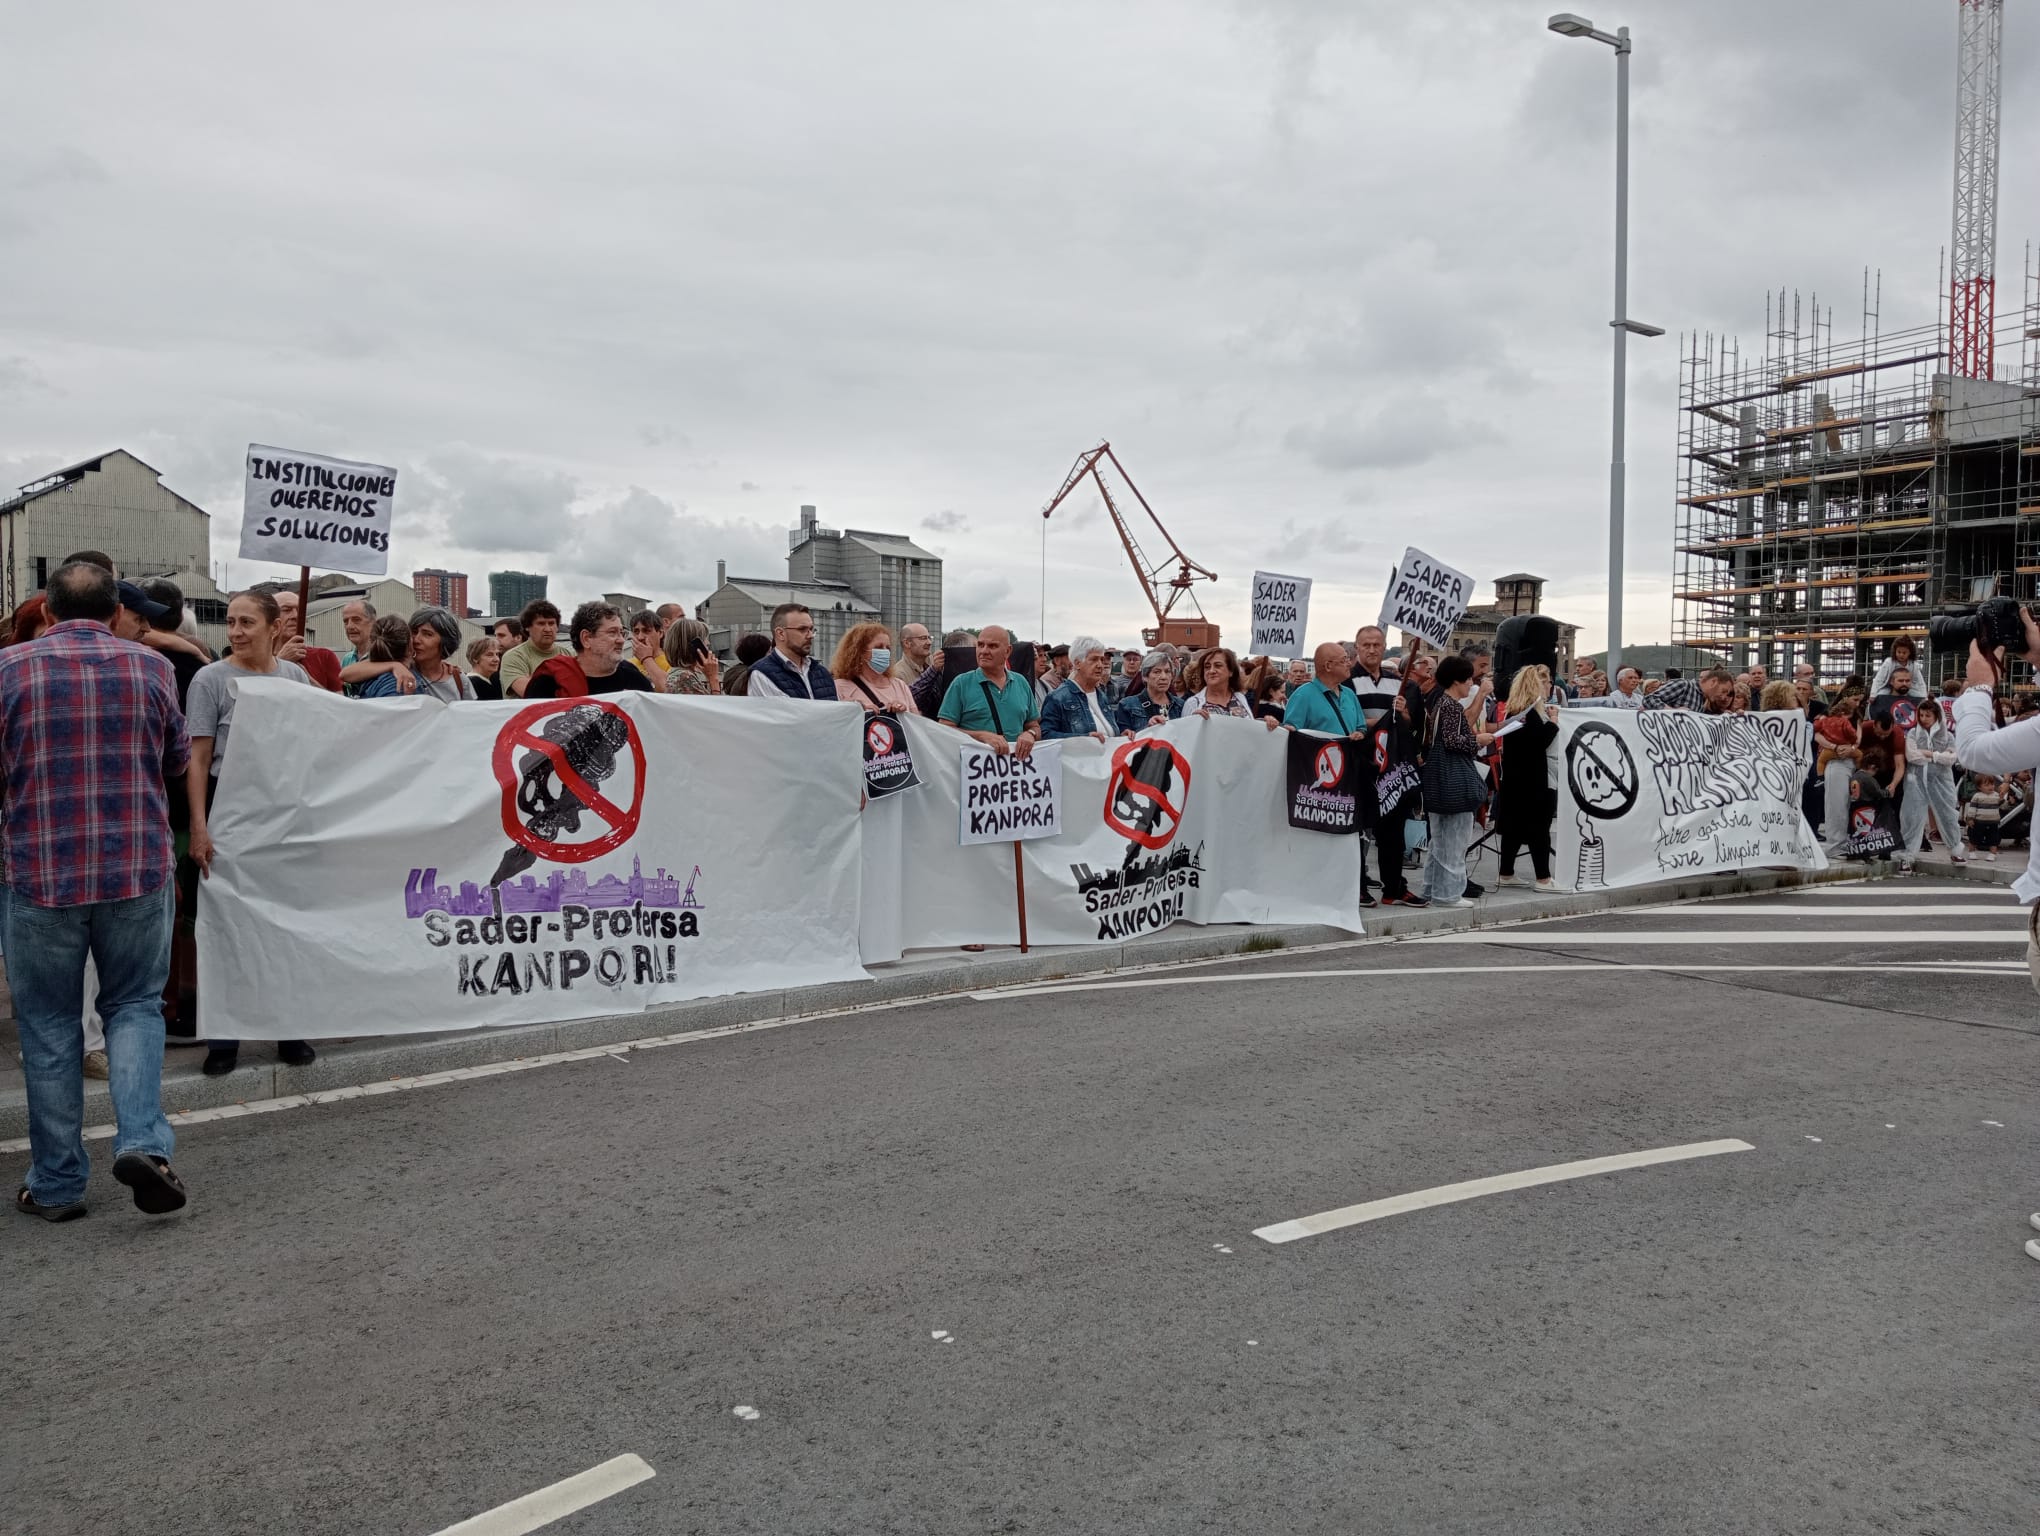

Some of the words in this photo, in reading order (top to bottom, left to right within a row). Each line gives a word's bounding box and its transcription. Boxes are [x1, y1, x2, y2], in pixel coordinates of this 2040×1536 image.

[252, 458, 395, 497] INSTITUCIONES
[256, 517, 389, 552] SOLUCIONES
[1254, 581, 1296, 602] SADER
[1405, 560, 1462, 602] SADER
[1394, 581, 1461, 626] PROFERSA
[1393, 605, 1451, 647] KANPORA
[869, 765, 909, 780] KANPORA!
[968, 752, 1036, 780] SADER
[968, 776, 1052, 808] PROFERSA
[970, 802, 1054, 834] KANPORA
[424, 900, 700, 946] Sader-Profersa
